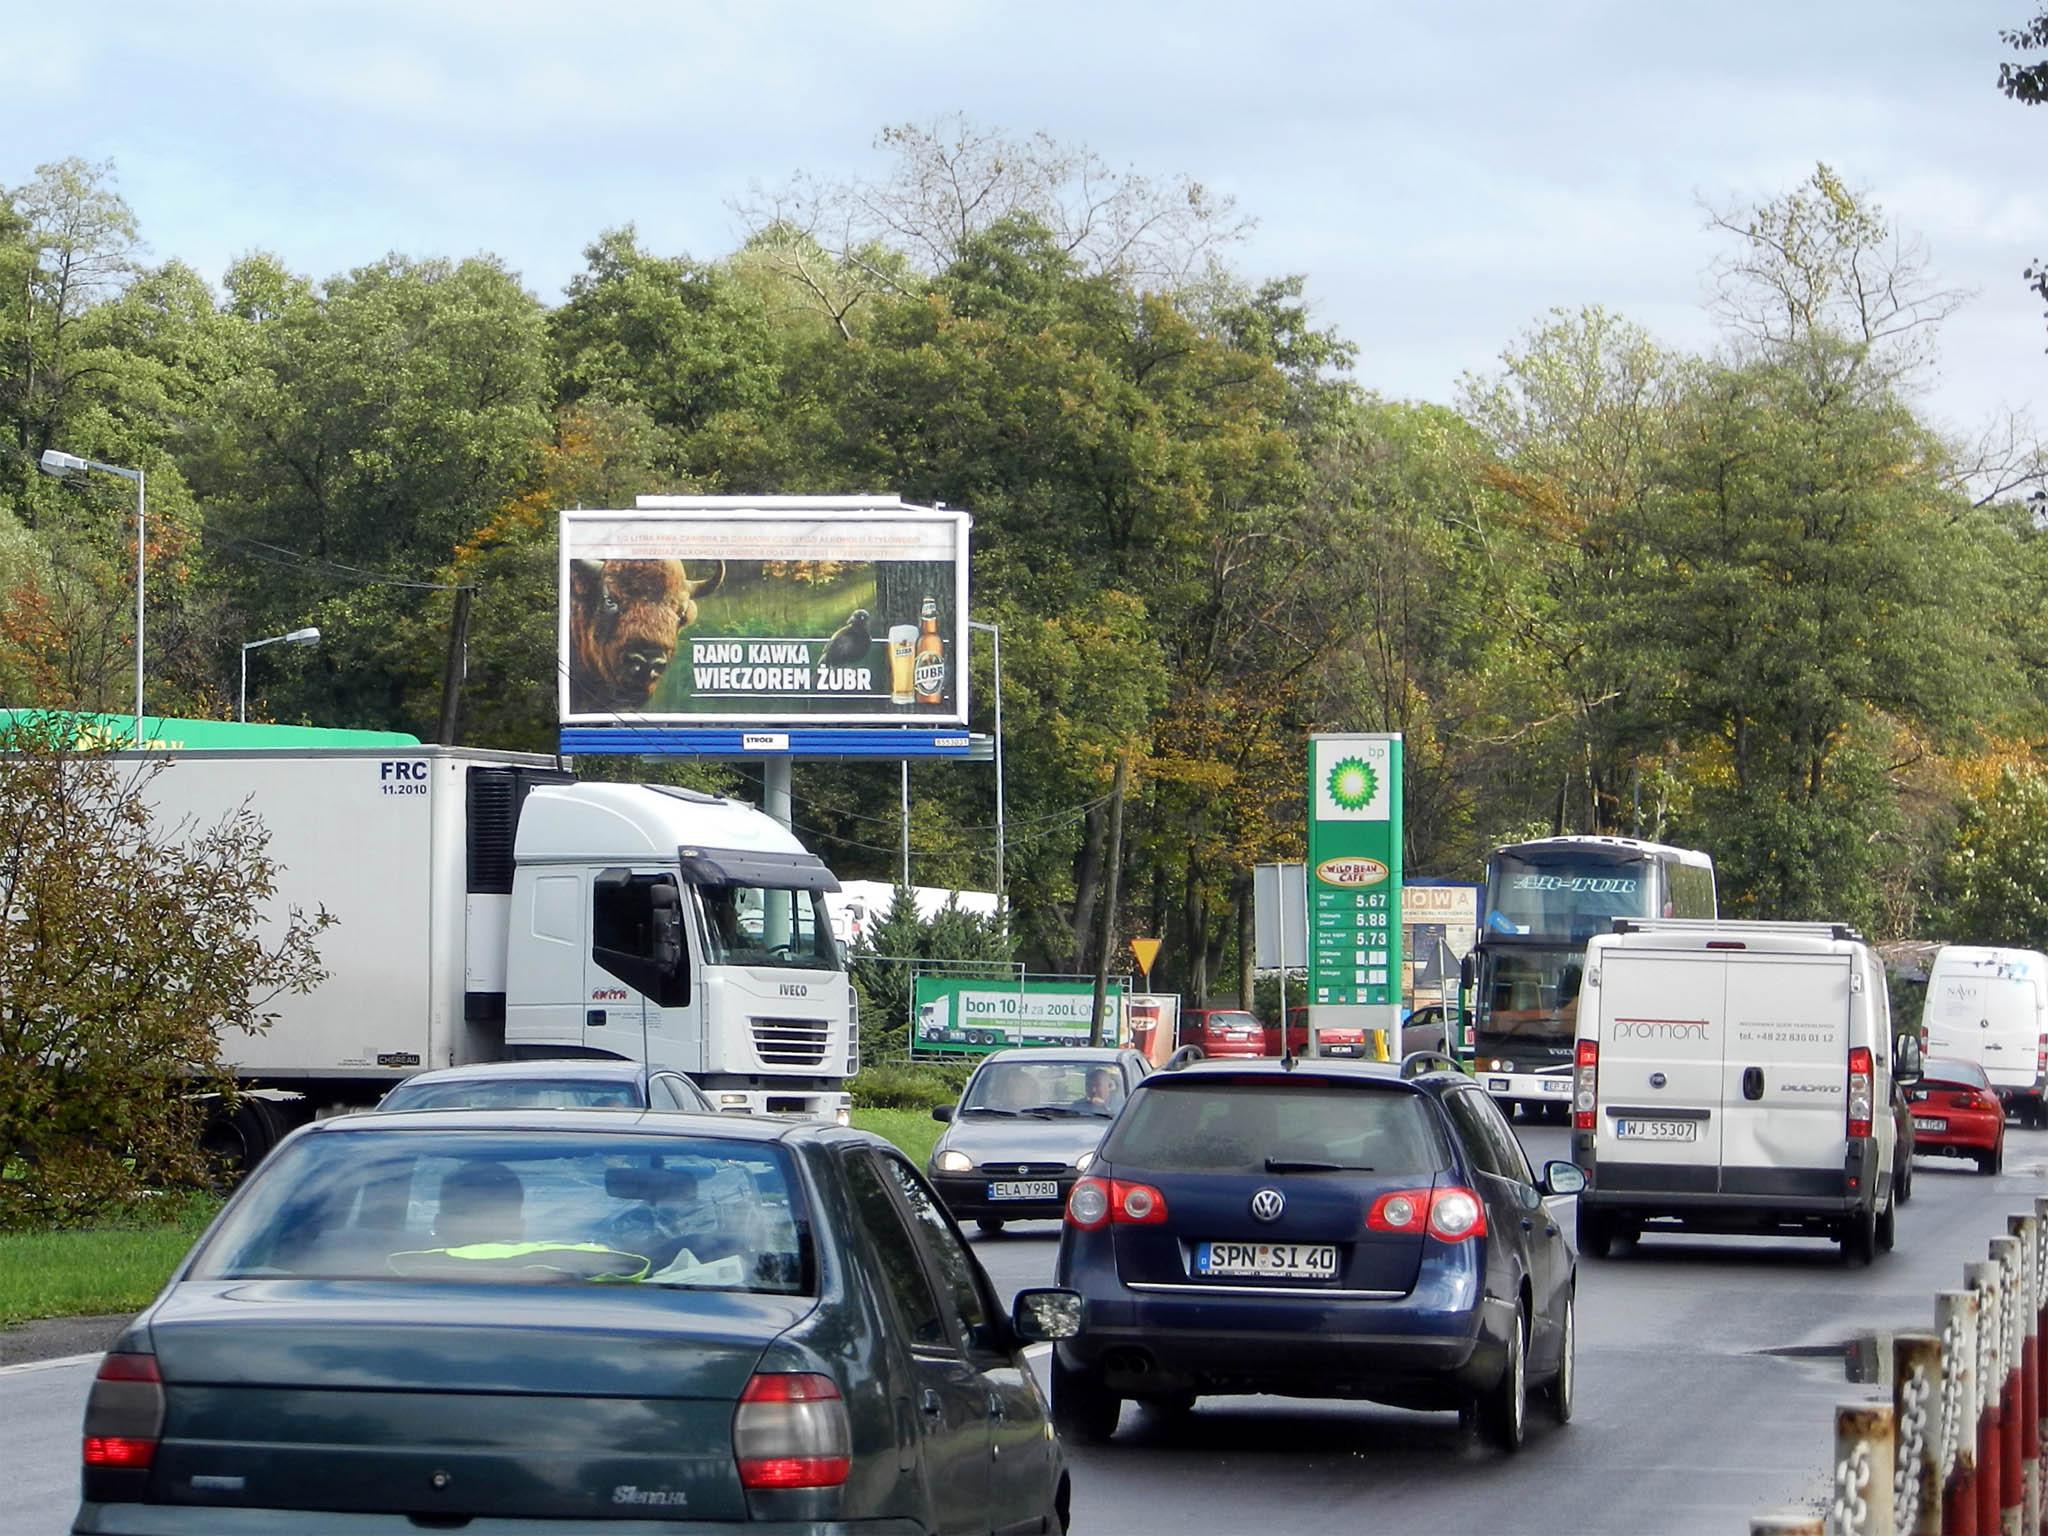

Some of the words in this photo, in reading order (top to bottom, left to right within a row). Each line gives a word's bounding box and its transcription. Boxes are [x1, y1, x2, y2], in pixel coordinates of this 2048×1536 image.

[693, 644, 743, 664] RANO
[748, 644, 810, 664] KAWKA
[693, 667, 811, 690] WIECZOREM
[816, 663, 872, 691] ŻUBR
[1368, 744, 1385, 760] bp
[381, 762, 427, 780] FRC
[382, 784, 427, 795] 11.2010
[1353, 864, 1377, 873] BEAN
[1356, 894, 1386, 907] 5.67
[1356, 913, 1387, 926] 5.88
[1356, 932, 1386, 945] 5.73
[779, 984, 807, 997] IVECO
[966, 996, 996, 1014] bon
[1000, 998, 1016, 1014] 10
[1031, 1005, 1044, 1016] za
[1613, 1018, 1709, 1042] promont
[1775, 1033, 1787, 1041] 22
[1627, 1122, 1645, 1136] WJ
[1651, 1122, 1693, 1137] 55307
[995, 1183, 1021, 1196] ELA
[1025, 1182, 1056, 1196] Y980
[1211, 1245, 1257, 1267] SPN
[1271, 1246, 1299, 1269] SI
[1306, 1248, 1333, 1269] 40
